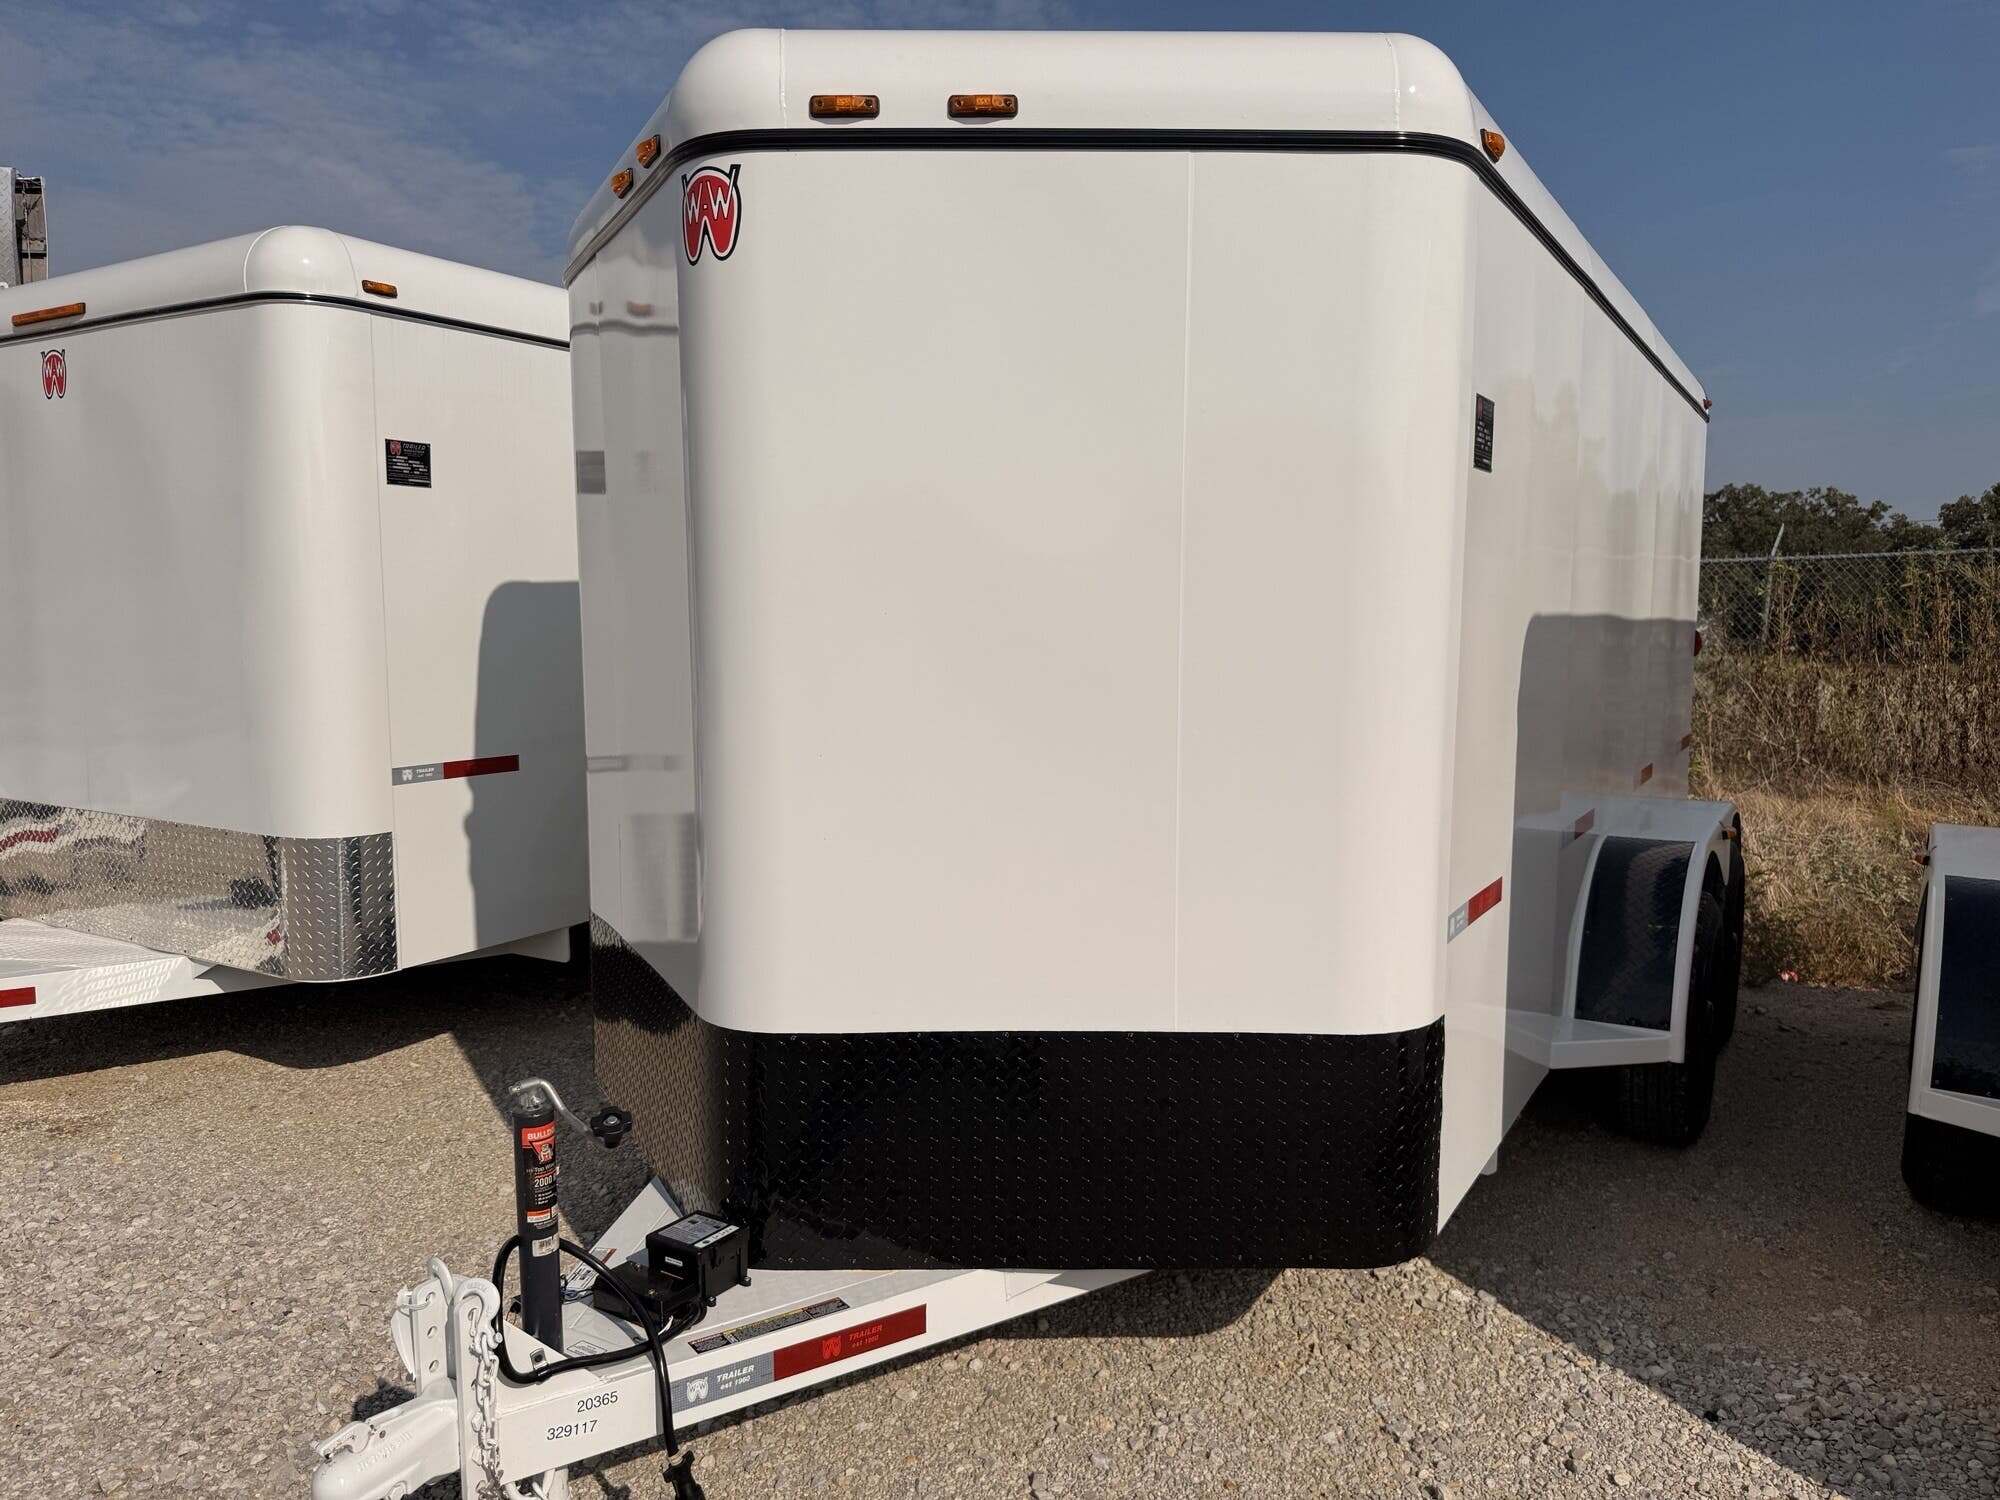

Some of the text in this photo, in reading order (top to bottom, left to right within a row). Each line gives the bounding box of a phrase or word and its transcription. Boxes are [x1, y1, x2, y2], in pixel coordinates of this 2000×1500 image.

[527, 1126, 555, 1140] BULLD
[534, 1176, 552, 1187] 2000
[849, 1324, 883, 1341] TRAILER
[717, 1365, 755, 1382] TRAILER
[577, 1391, 618, 1413] 20365
[546, 1420, 598, 1440] 329117
